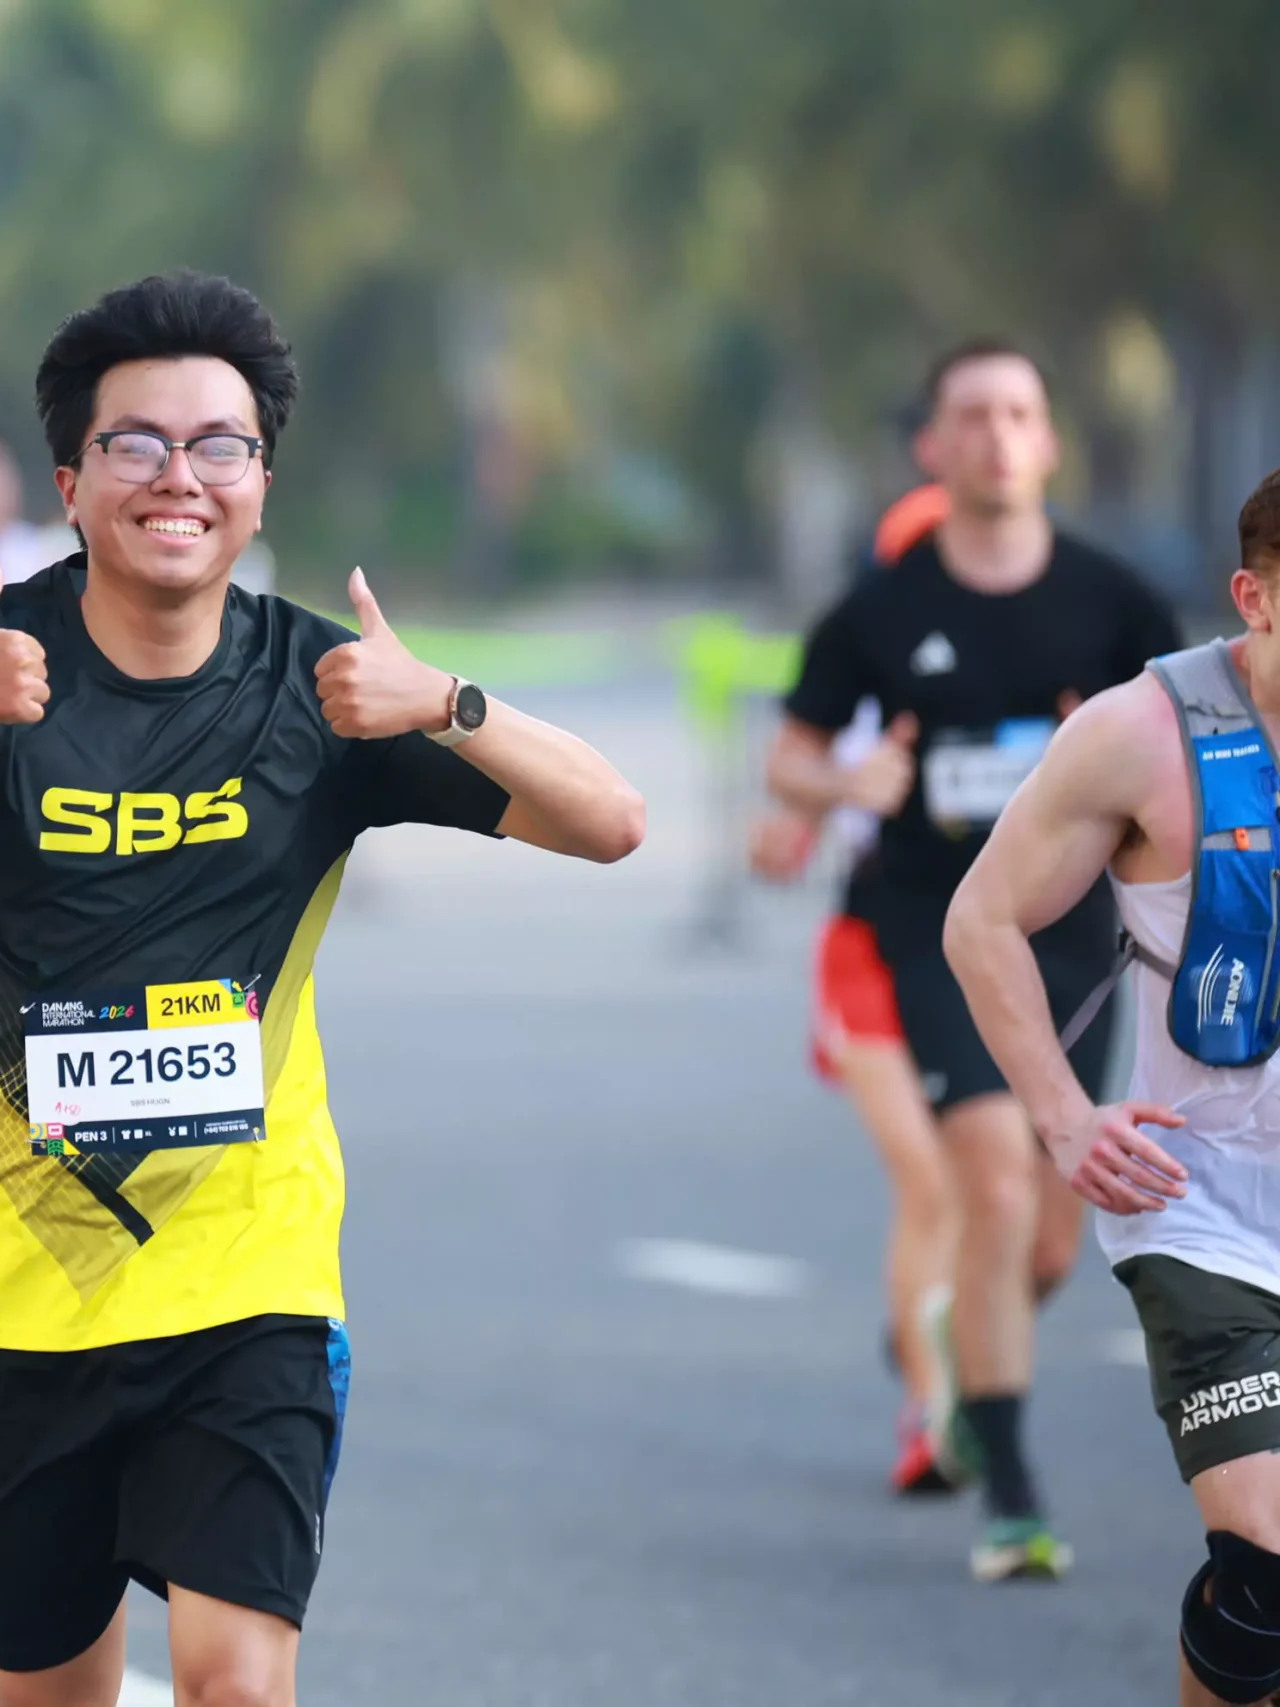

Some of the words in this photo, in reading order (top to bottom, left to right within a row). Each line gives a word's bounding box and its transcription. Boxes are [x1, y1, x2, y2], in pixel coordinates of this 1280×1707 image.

[39, 777, 249, 855] SBS
[41, 1001, 84, 1013] DANANG
[99, 1004, 136, 1020] 2026
[161, 993, 221, 1017] 21KM
[42, 1009, 96, 1020] INTERNATIONAL
[42, 1018, 85, 1028] MARATHON
[56, 1051, 96, 1088] M
[108, 1041, 238, 1086] 21653
[74, 1131, 99, 1143] PEN
[100, 1130, 108, 1141] 3
[1180, 1370, 1280, 1414] UNDER
